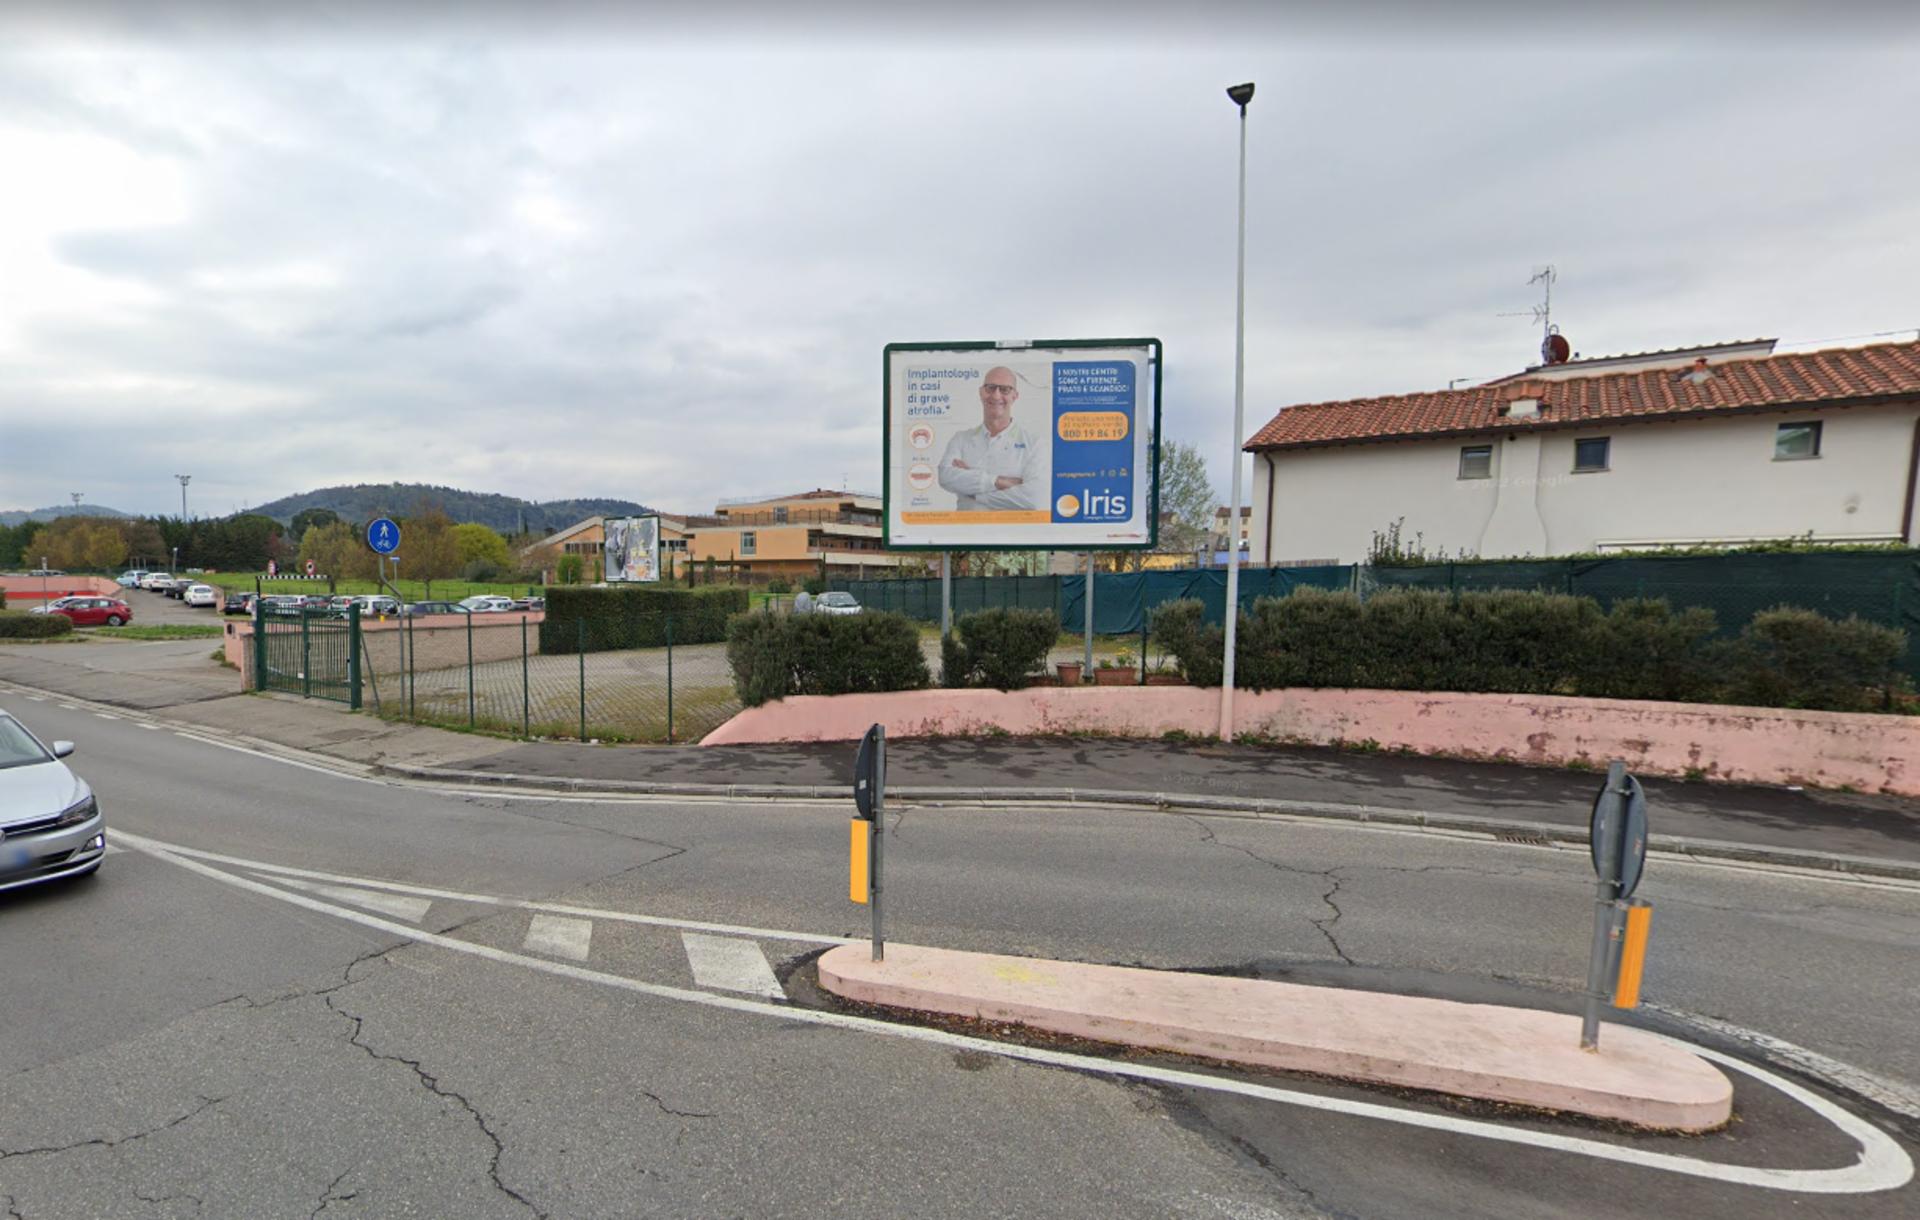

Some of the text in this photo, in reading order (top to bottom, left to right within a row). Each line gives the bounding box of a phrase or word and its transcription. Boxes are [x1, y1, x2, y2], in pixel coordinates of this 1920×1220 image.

[907, 368, 979, 380] Implantologia
[907, 381, 941, 390] in casi
[907, 394, 950, 405] di grave
[1063, 429, 1081, 438] 800
[1083, 488, 1126, 515] Iris
